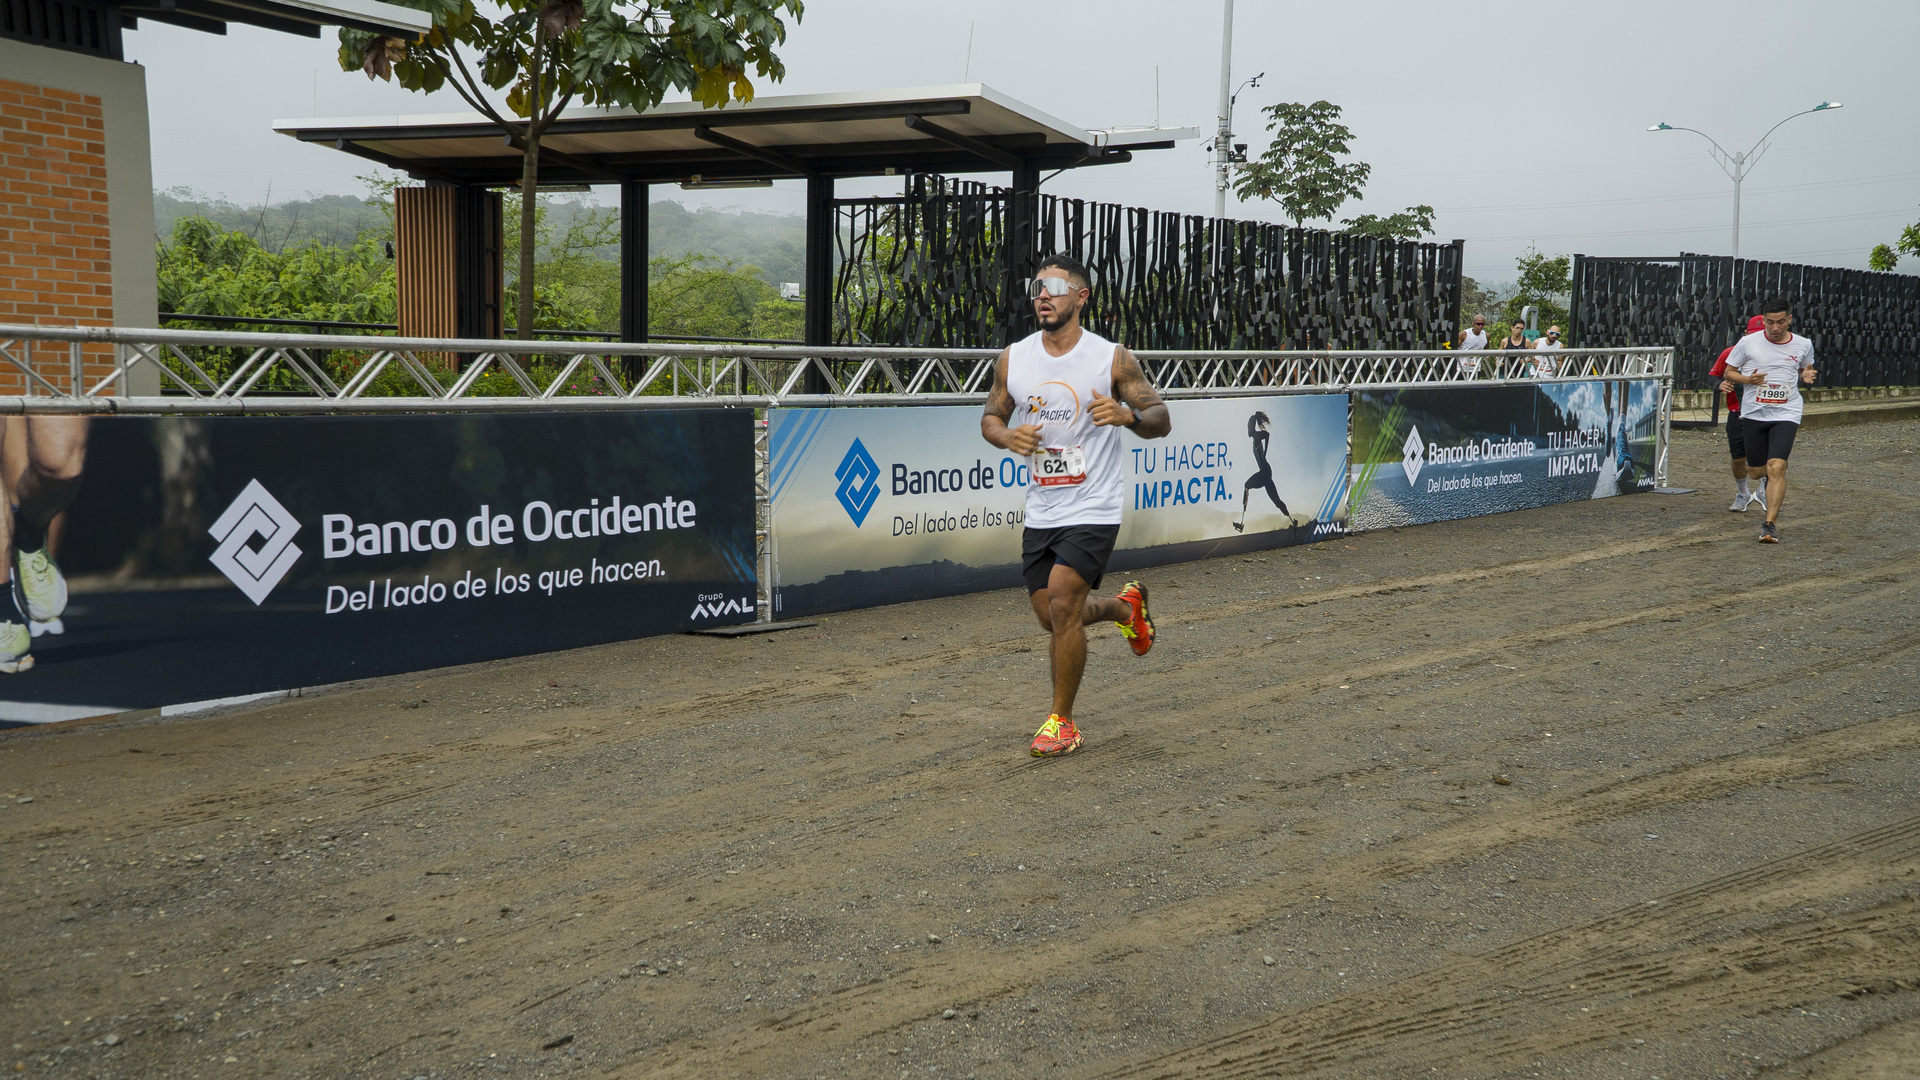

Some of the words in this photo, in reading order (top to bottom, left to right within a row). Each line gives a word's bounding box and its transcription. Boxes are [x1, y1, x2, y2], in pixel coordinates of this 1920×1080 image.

[1762, 390, 1786, 398] 1989
[1040, 409, 1071, 421] PACIFIC
[1428, 442, 1464, 466] Banco
[1466, 439, 1480, 462] de
[1482, 437, 1534, 460] Occidente
[1548, 432, 1561, 452] TU
[1564, 428, 1602, 450] HACER,
[1132, 448, 1156, 474] TU
[1164, 442, 1232, 472] HACER,
[1548, 452, 1602, 478] IMPACTA.
[892, 463, 963, 496] Banco
[968, 459, 994, 490] de
[1428, 477, 1442, 492] Del
[1442, 475, 1459, 491] lado
[1460, 474, 1470, 488] de
[1472, 473, 1482, 488] los
[1484, 475, 1498, 489] que
[1499, 470, 1523, 484] hacen.
[1637, 477, 1654, 488] AVAL
[1134, 475, 1232, 510] IMPACTA.
[322, 513, 458, 559] Banco
[466, 504, 514, 547] de
[522, 496, 696, 542] Occidente
[892, 513, 918, 536] Del
[923, 510, 956, 534] lado
[960, 508, 978, 530] de
[982, 506, 1002, 527] los
[1006, 510, 1026, 530] qu
[1313, 522, 1343, 536] AVAL
[326, 580, 376, 614] Del
[384, 574, 446, 608] lado
[453, 570, 487, 600] de
[494, 567, 530, 594] los
[538, 568, 584, 596] que
[590, 558, 666, 584] hacen.
[698, 592, 724, 602] Grupo
[690, 597, 754, 621] AVAL
